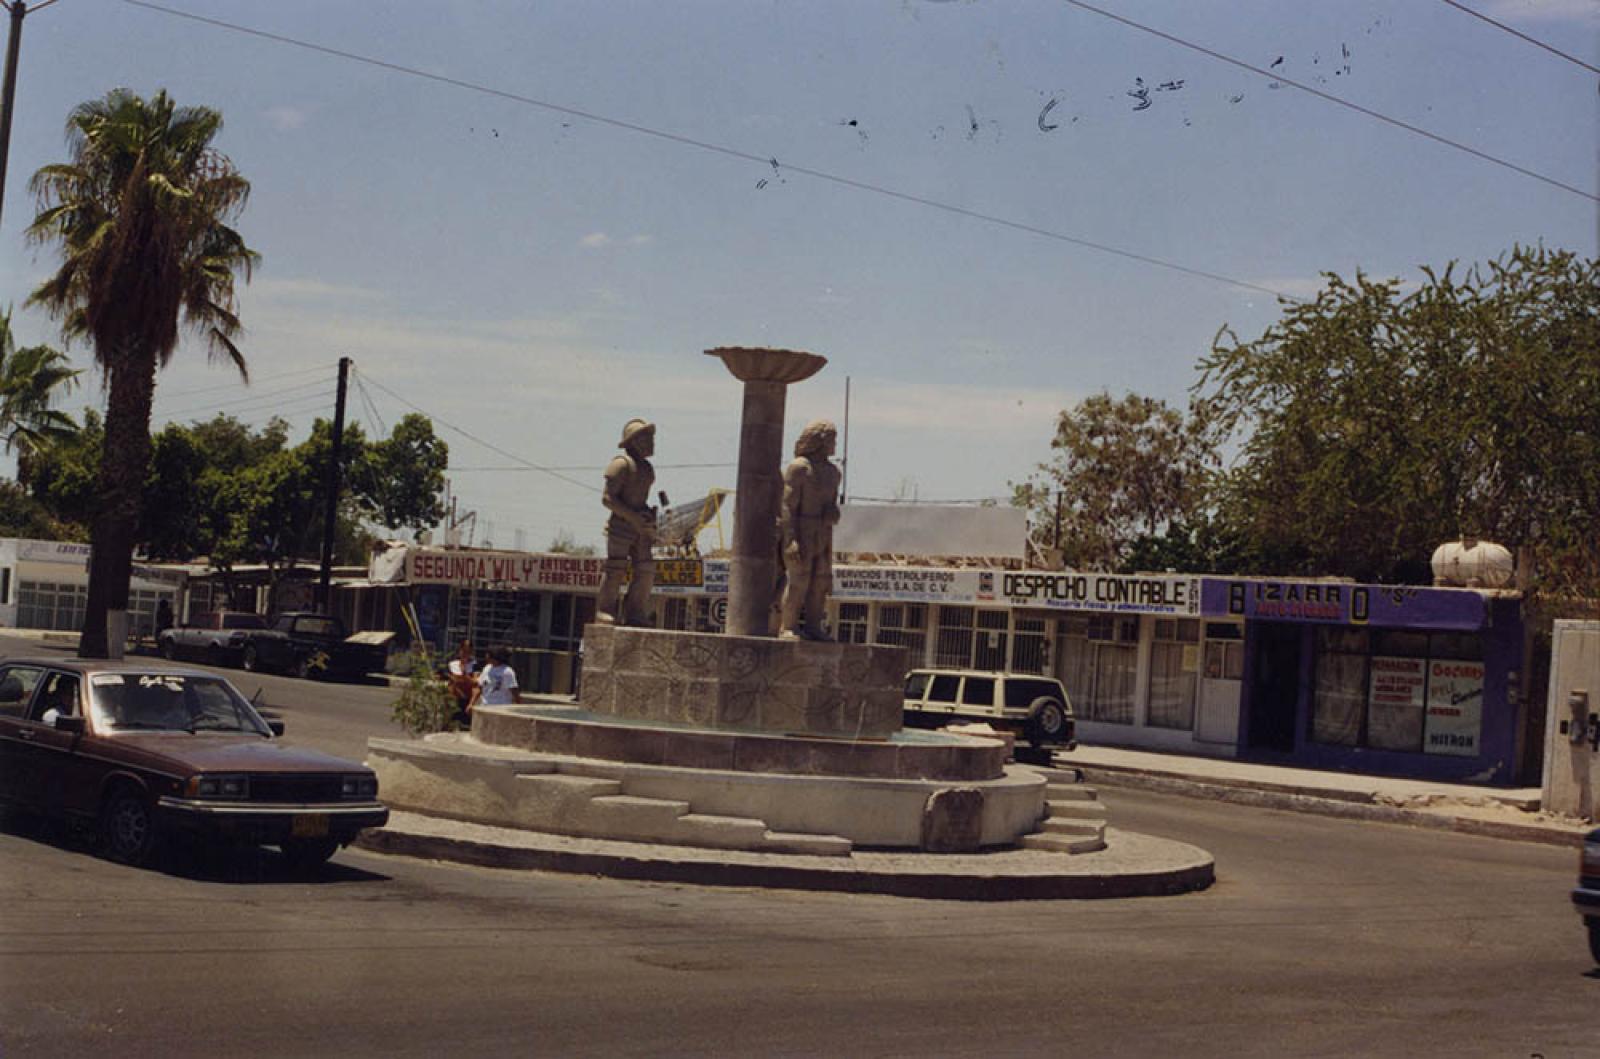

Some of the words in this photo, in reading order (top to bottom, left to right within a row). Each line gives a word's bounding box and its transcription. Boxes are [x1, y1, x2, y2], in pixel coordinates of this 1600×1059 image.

[413, 555, 487, 580] SEGUNDA
[540, 559, 598, 573] ARTICULOS
[835, 569, 881, 580] SERVICIOS
[1003, 573, 1087, 601] DESPACHO
[1096, 577, 1186, 606] CONTABLE
[1083, 599, 1108, 609] fiscal
